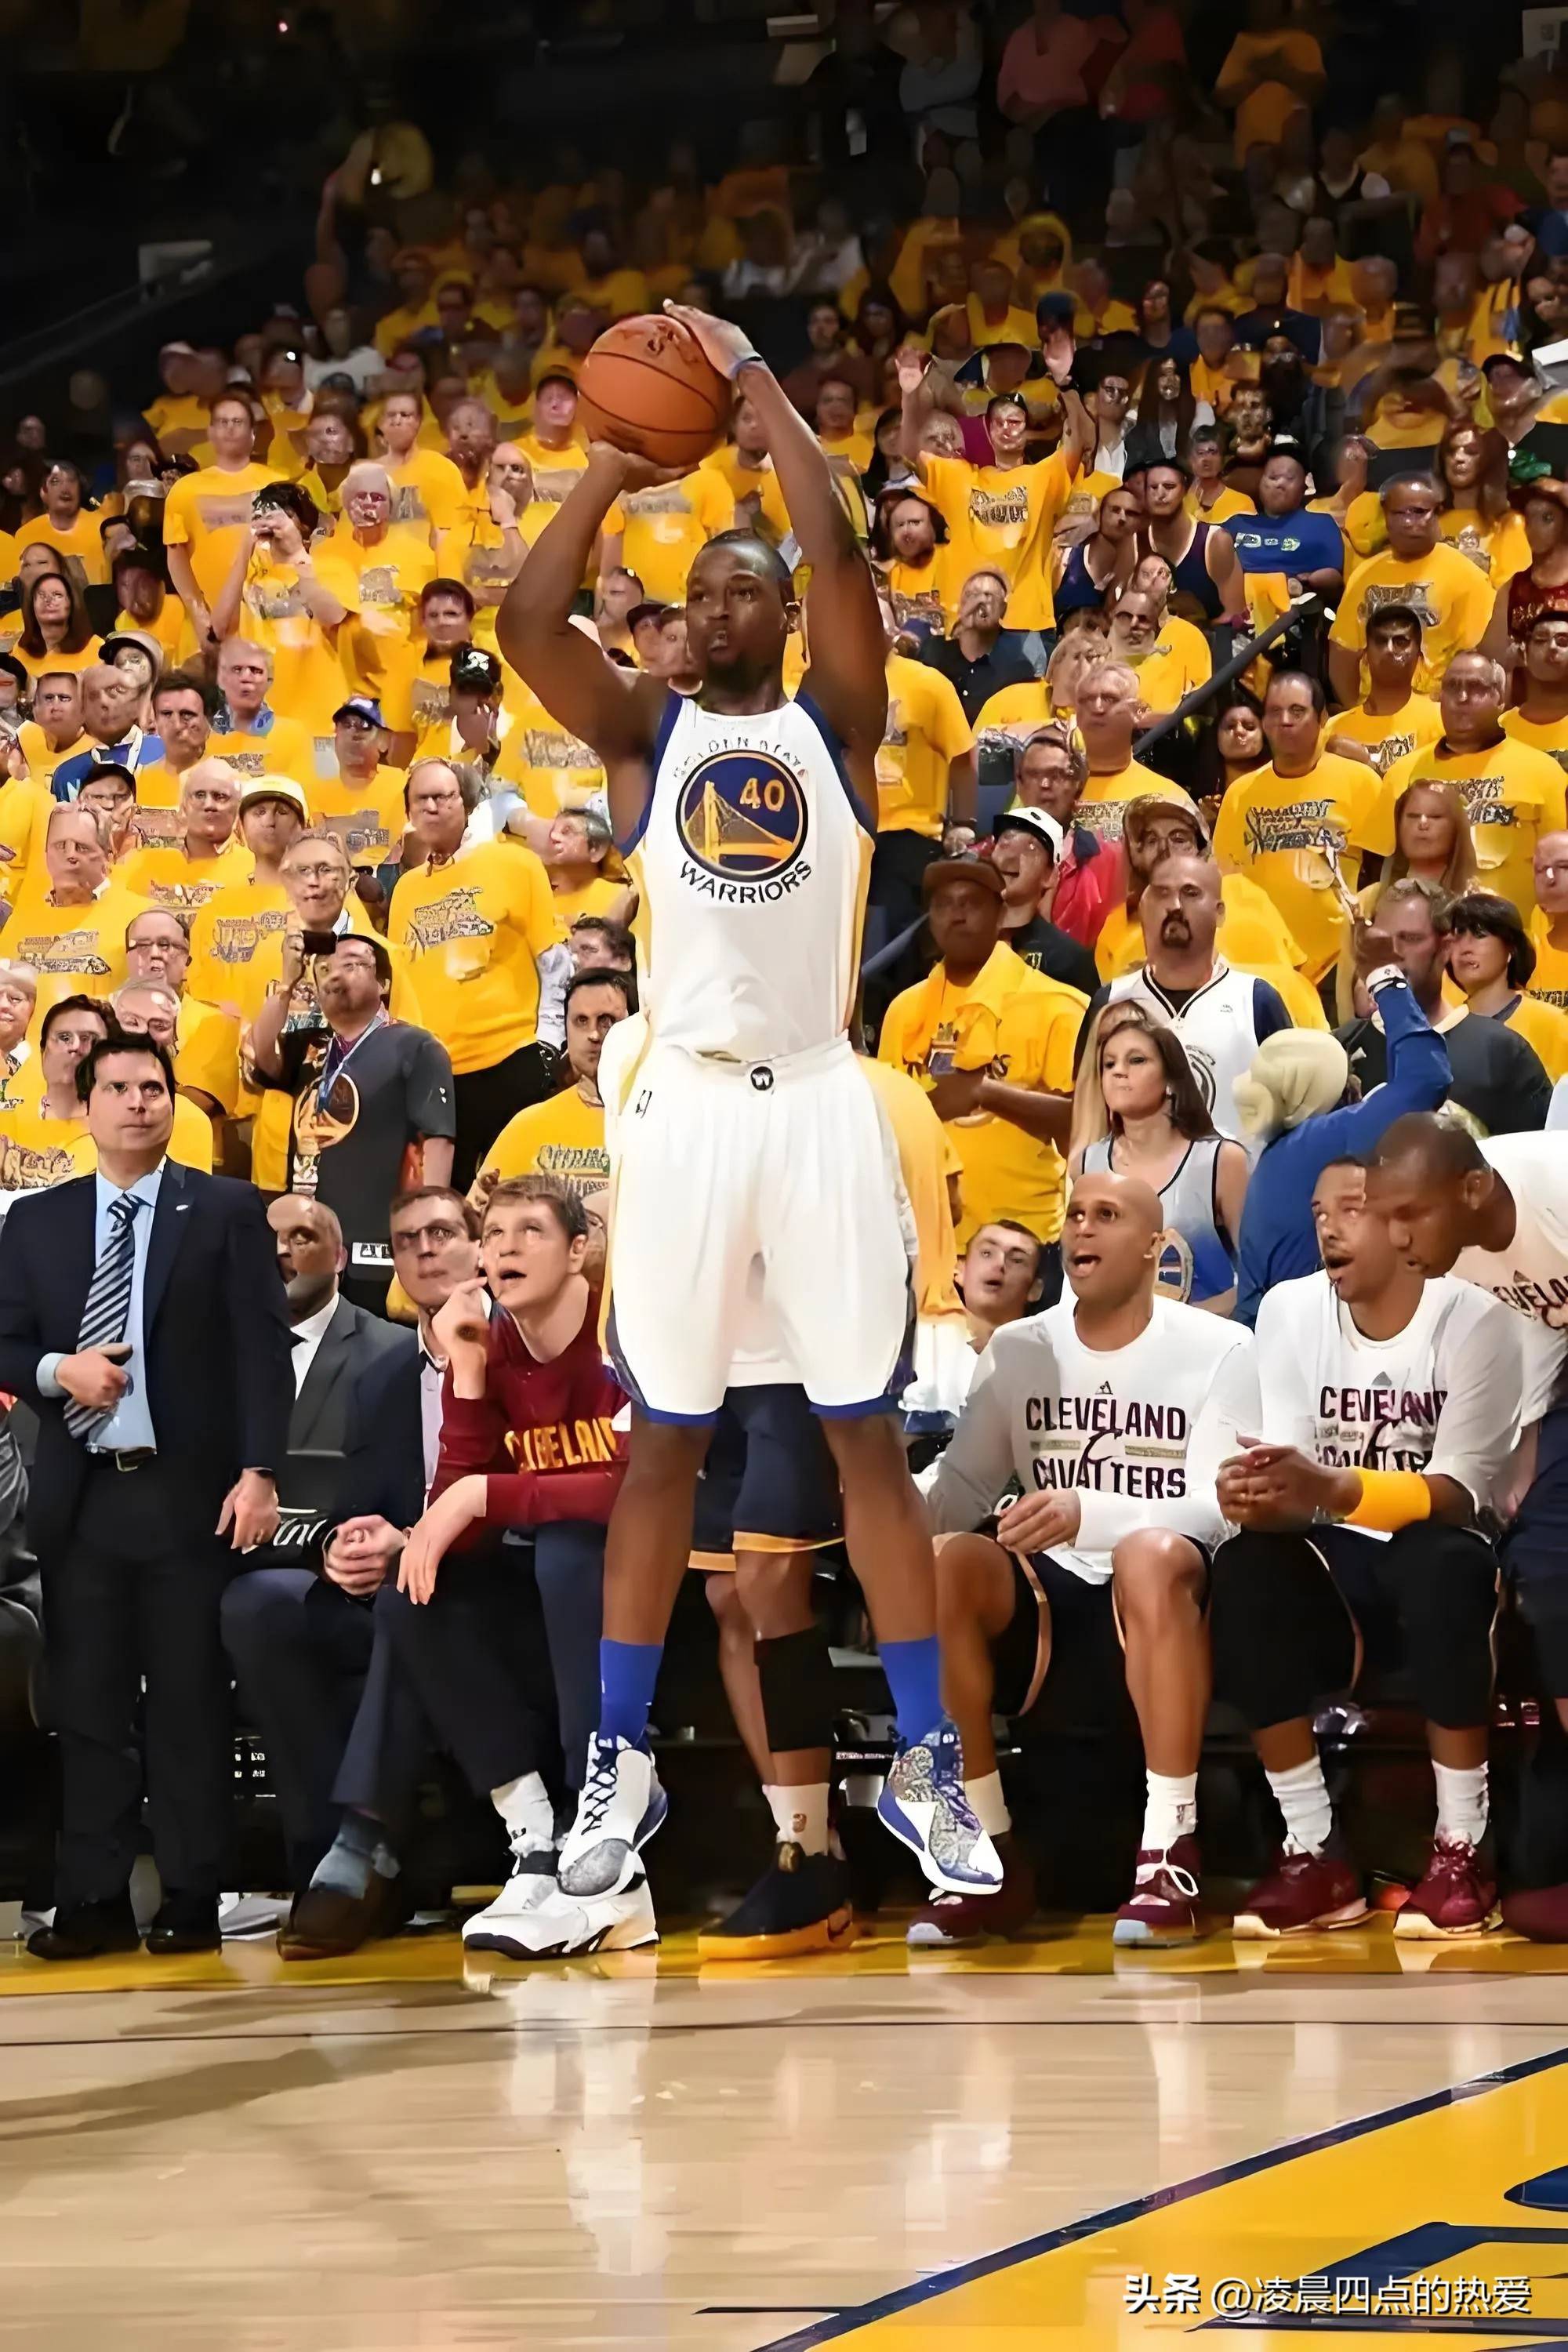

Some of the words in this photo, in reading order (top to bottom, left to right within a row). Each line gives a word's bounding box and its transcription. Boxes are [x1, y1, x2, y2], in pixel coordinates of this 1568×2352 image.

[739, 777, 786, 812] 40
[680, 860, 812, 903] WARRIORS
[1025, 1396, 1187, 1441] CLEVELAND
